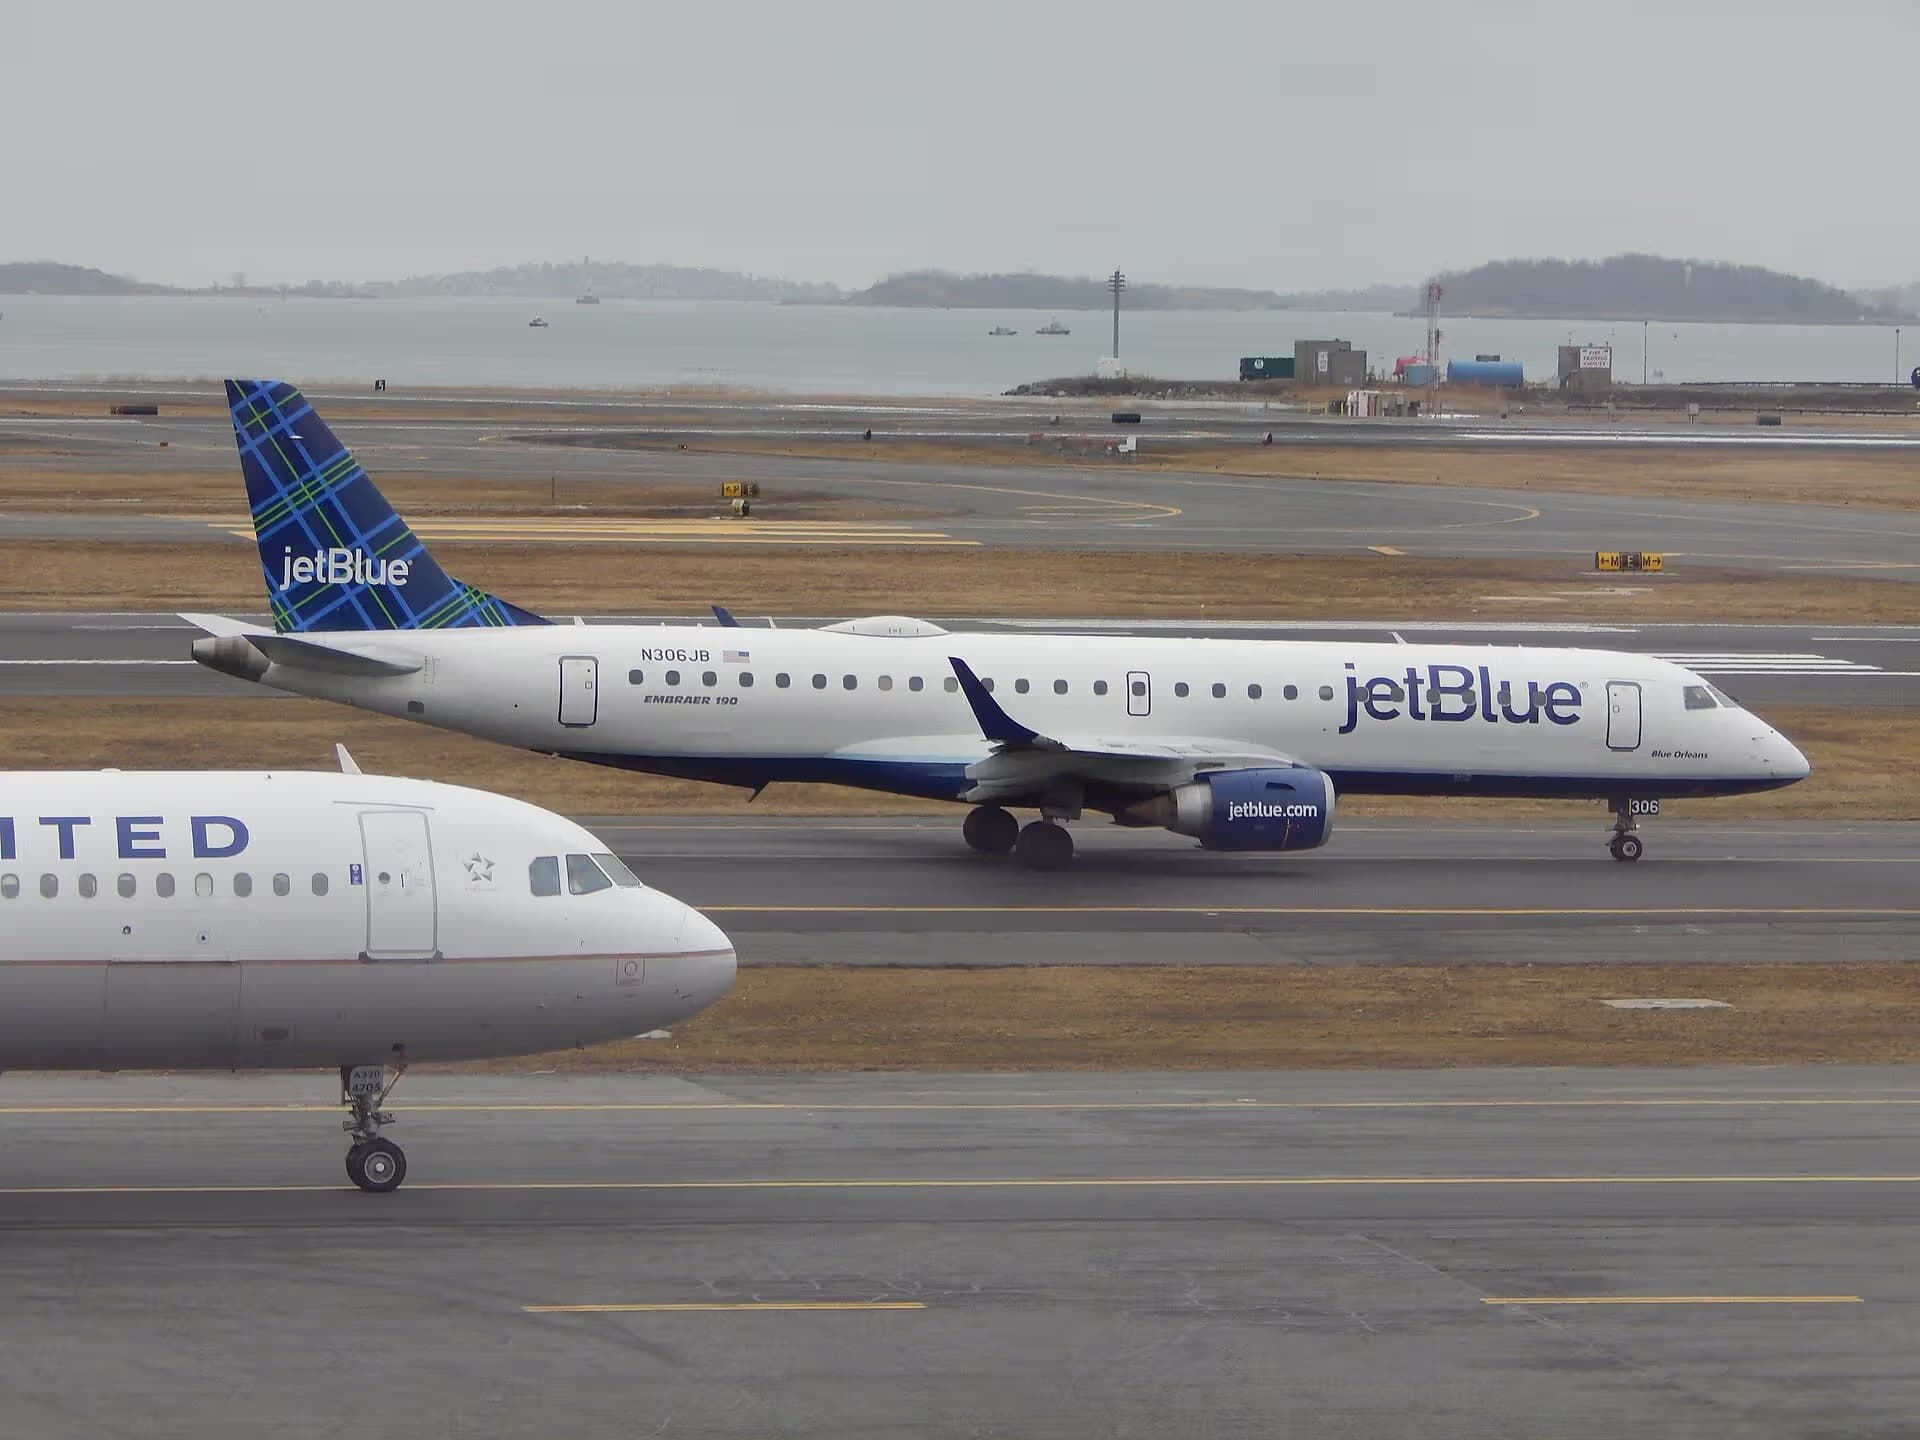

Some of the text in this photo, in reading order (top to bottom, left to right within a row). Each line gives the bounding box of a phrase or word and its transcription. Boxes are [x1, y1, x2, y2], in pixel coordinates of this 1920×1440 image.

[1611, 555, 1651, 567] M E M
[280, 546, 409, 591] jetBlue
[641, 648, 710, 662] N306JB
[643, 695, 739, 706] EMBRAER 190
[1339, 663, 1582, 735] jetBlue
[1651, 750, 1708, 760] Blue Orleans
[1228, 801, 1318, 821] jetblue.com
[1631, 800, 1658, 814] 306
